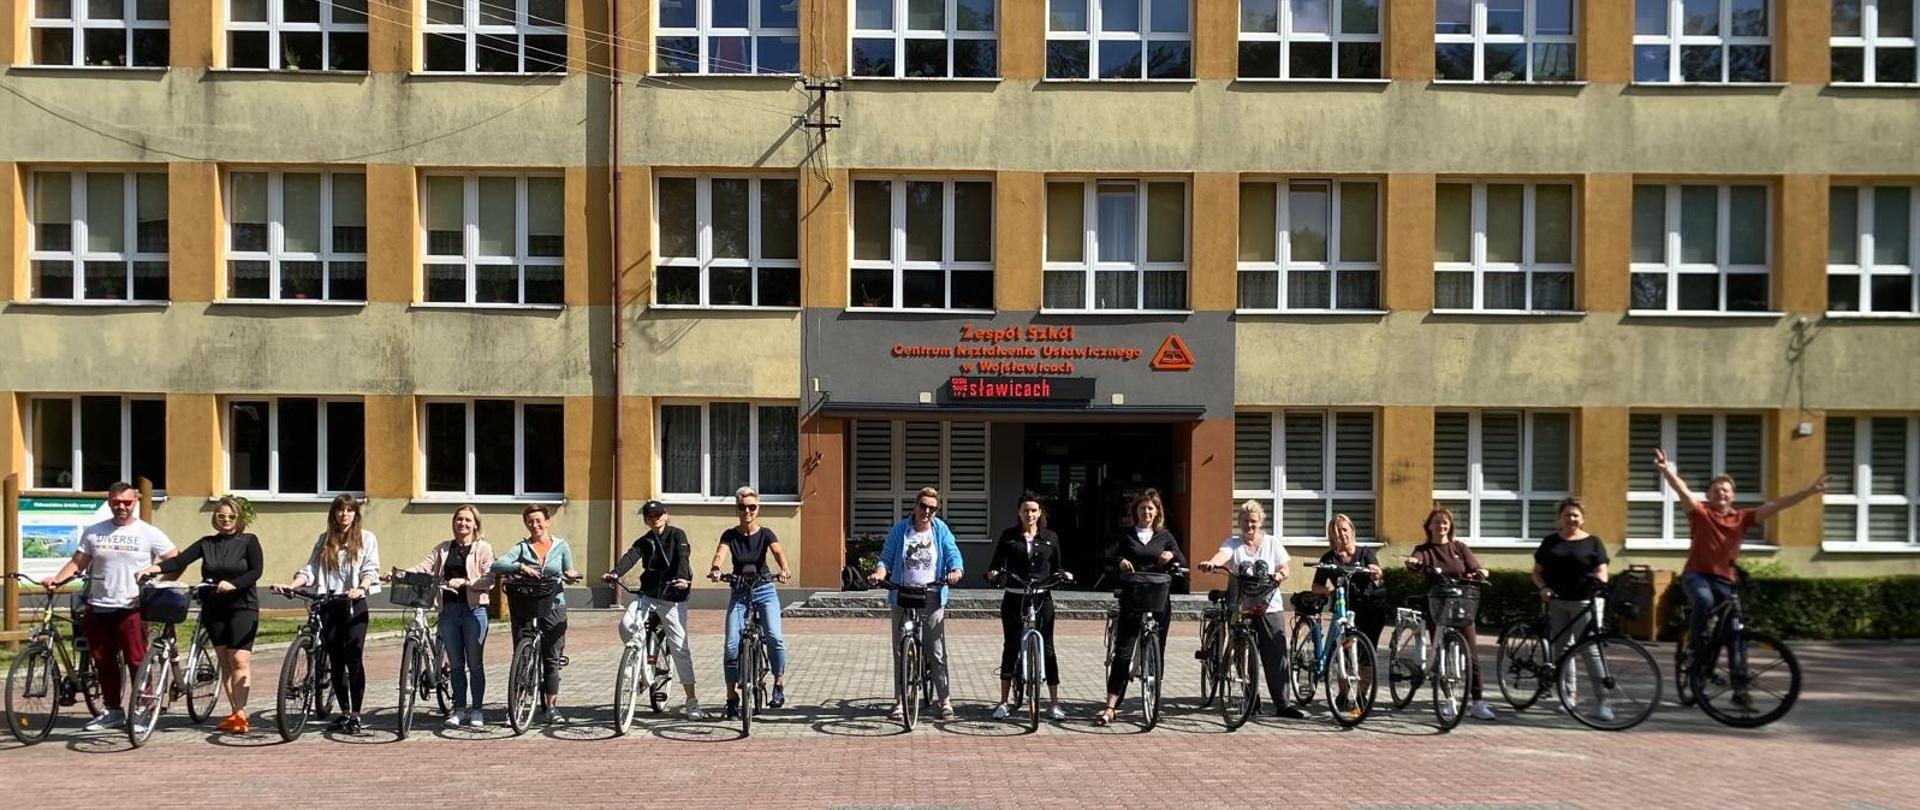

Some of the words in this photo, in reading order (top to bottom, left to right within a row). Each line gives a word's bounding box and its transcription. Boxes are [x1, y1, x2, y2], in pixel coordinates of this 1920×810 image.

[892, 344, 952, 357] Centrum
[1042, 345, 1142, 361] Ustawicznego
[961, 363, 973, 373] w
[970, 378, 1050, 397] sławicach
[96, 534, 140, 545] DIVERSE
